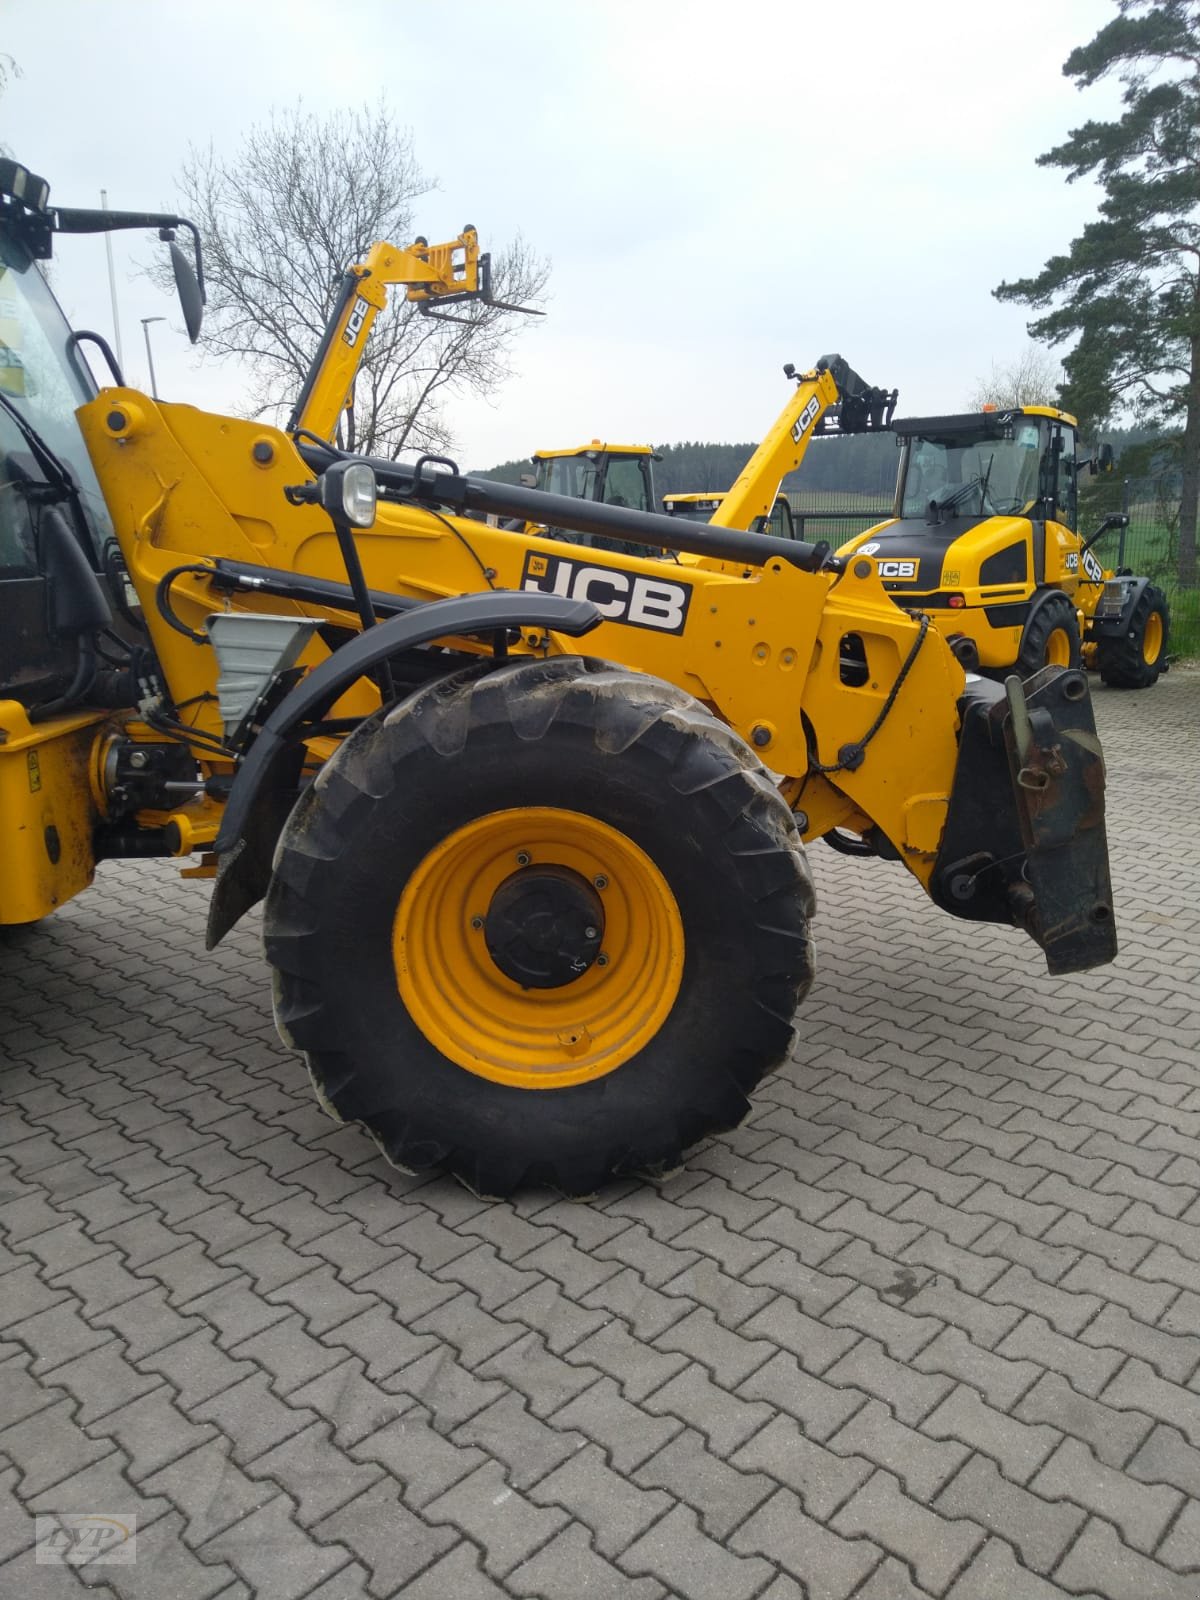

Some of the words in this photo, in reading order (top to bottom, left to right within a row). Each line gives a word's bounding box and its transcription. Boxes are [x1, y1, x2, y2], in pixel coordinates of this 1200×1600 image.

[345, 298, 369, 346] JCB
[793, 396, 820, 442] JCB
[1065, 553, 1078, 568] JCB
[525, 561, 686, 630] JCB
